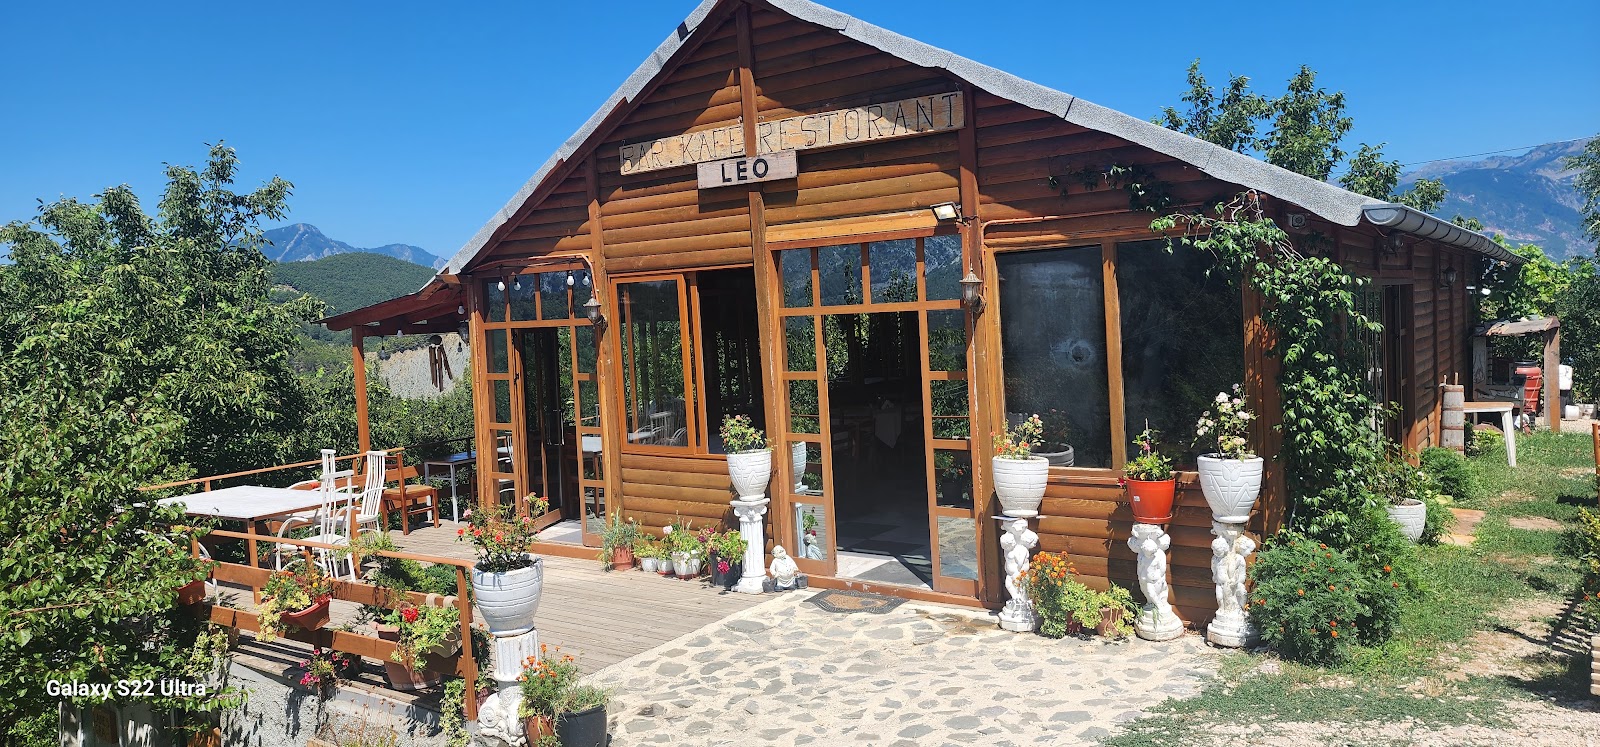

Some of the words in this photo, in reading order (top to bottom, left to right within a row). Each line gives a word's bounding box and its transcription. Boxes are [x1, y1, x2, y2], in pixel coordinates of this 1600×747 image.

[682, 126, 745, 165] KAFE
[758, 93, 958, 153] RESTORANT
[721, 158, 769, 183] LEO
